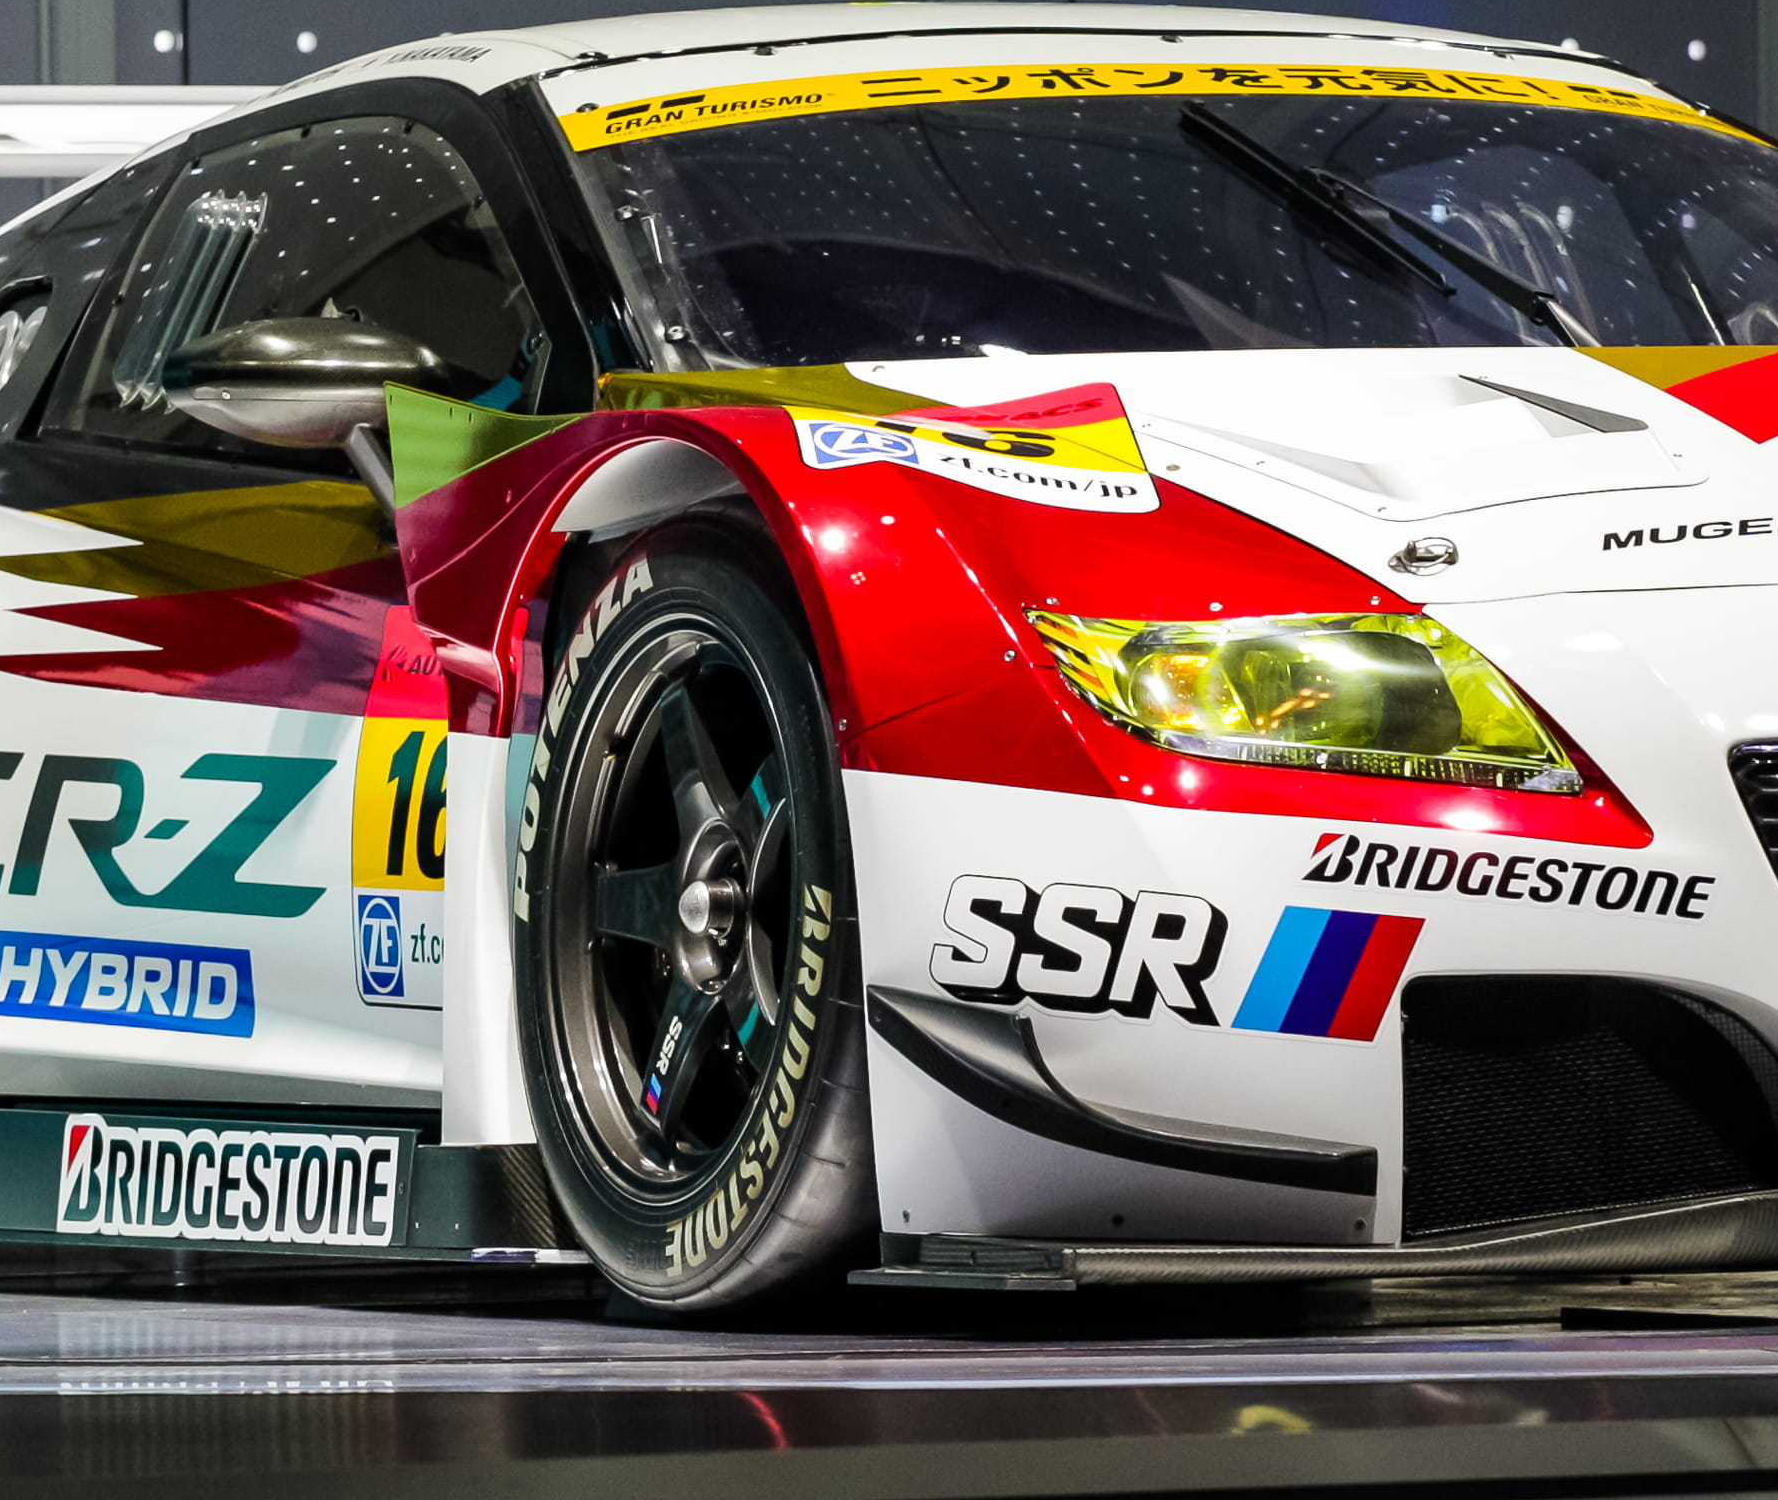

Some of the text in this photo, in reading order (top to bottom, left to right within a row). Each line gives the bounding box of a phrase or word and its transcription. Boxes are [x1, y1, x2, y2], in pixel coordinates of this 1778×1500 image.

[606, 93, 823, 135] GRAN TURISMO
[938, 453, 1138, 499] zf.com/jp
[513, 557, 654, 923] POTENZA
[1301, 832, 1716, 920] BRIDGESTONE
[929, 873, 1229, 1026] SSR
[655, 1015, 684, 1076] SSR
[665, 884, 833, 1278] BRIDGESTONE
[64, 1124, 392, 1238] BRIDGESTONE
